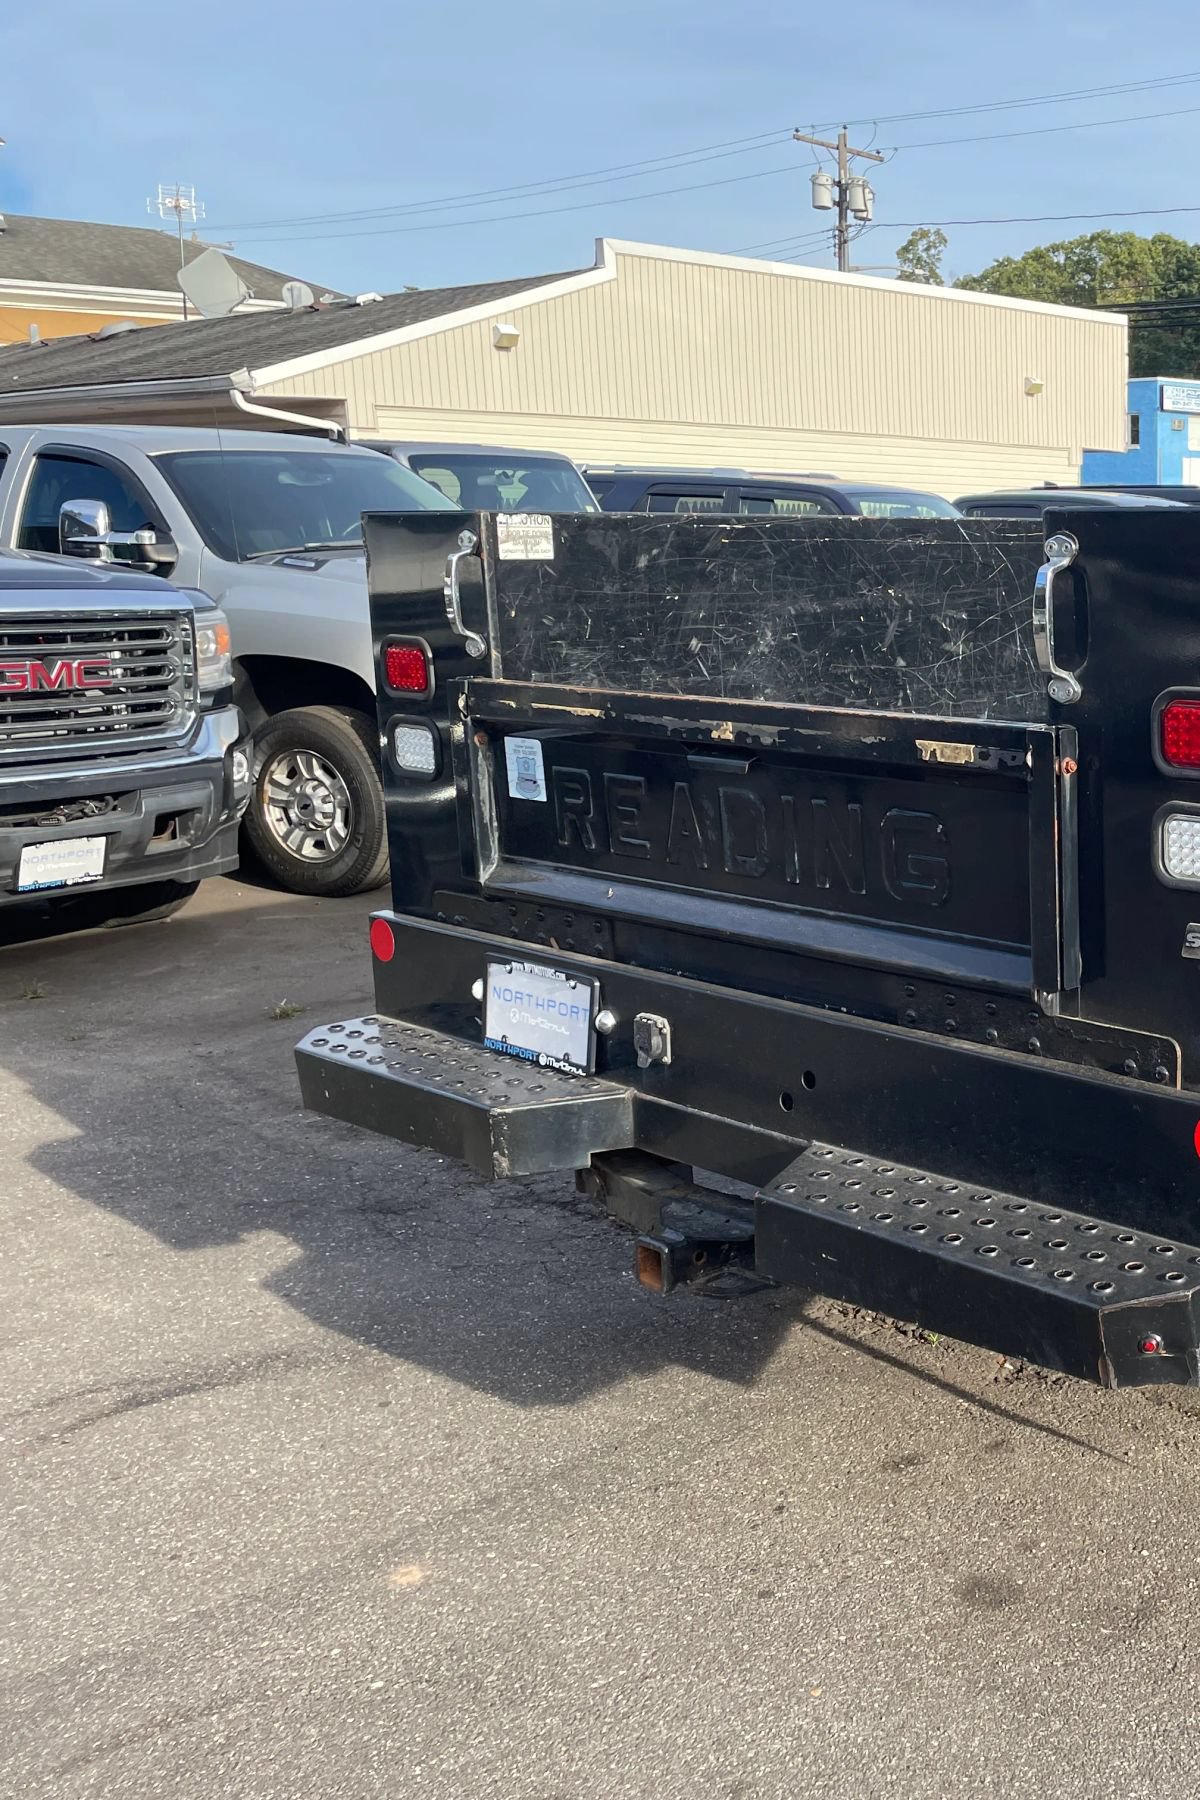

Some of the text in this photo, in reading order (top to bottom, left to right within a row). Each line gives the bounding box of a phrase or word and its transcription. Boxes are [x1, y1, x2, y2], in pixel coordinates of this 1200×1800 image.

[0, 659, 113, 692] GMC
[551, 765, 950, 906] READING
[23, 848, 102, 865] NORTHPORT
[493, 986, 589, 1021] NORTHPORT
[484, 1038, 538, 1060] NORTHPORT
